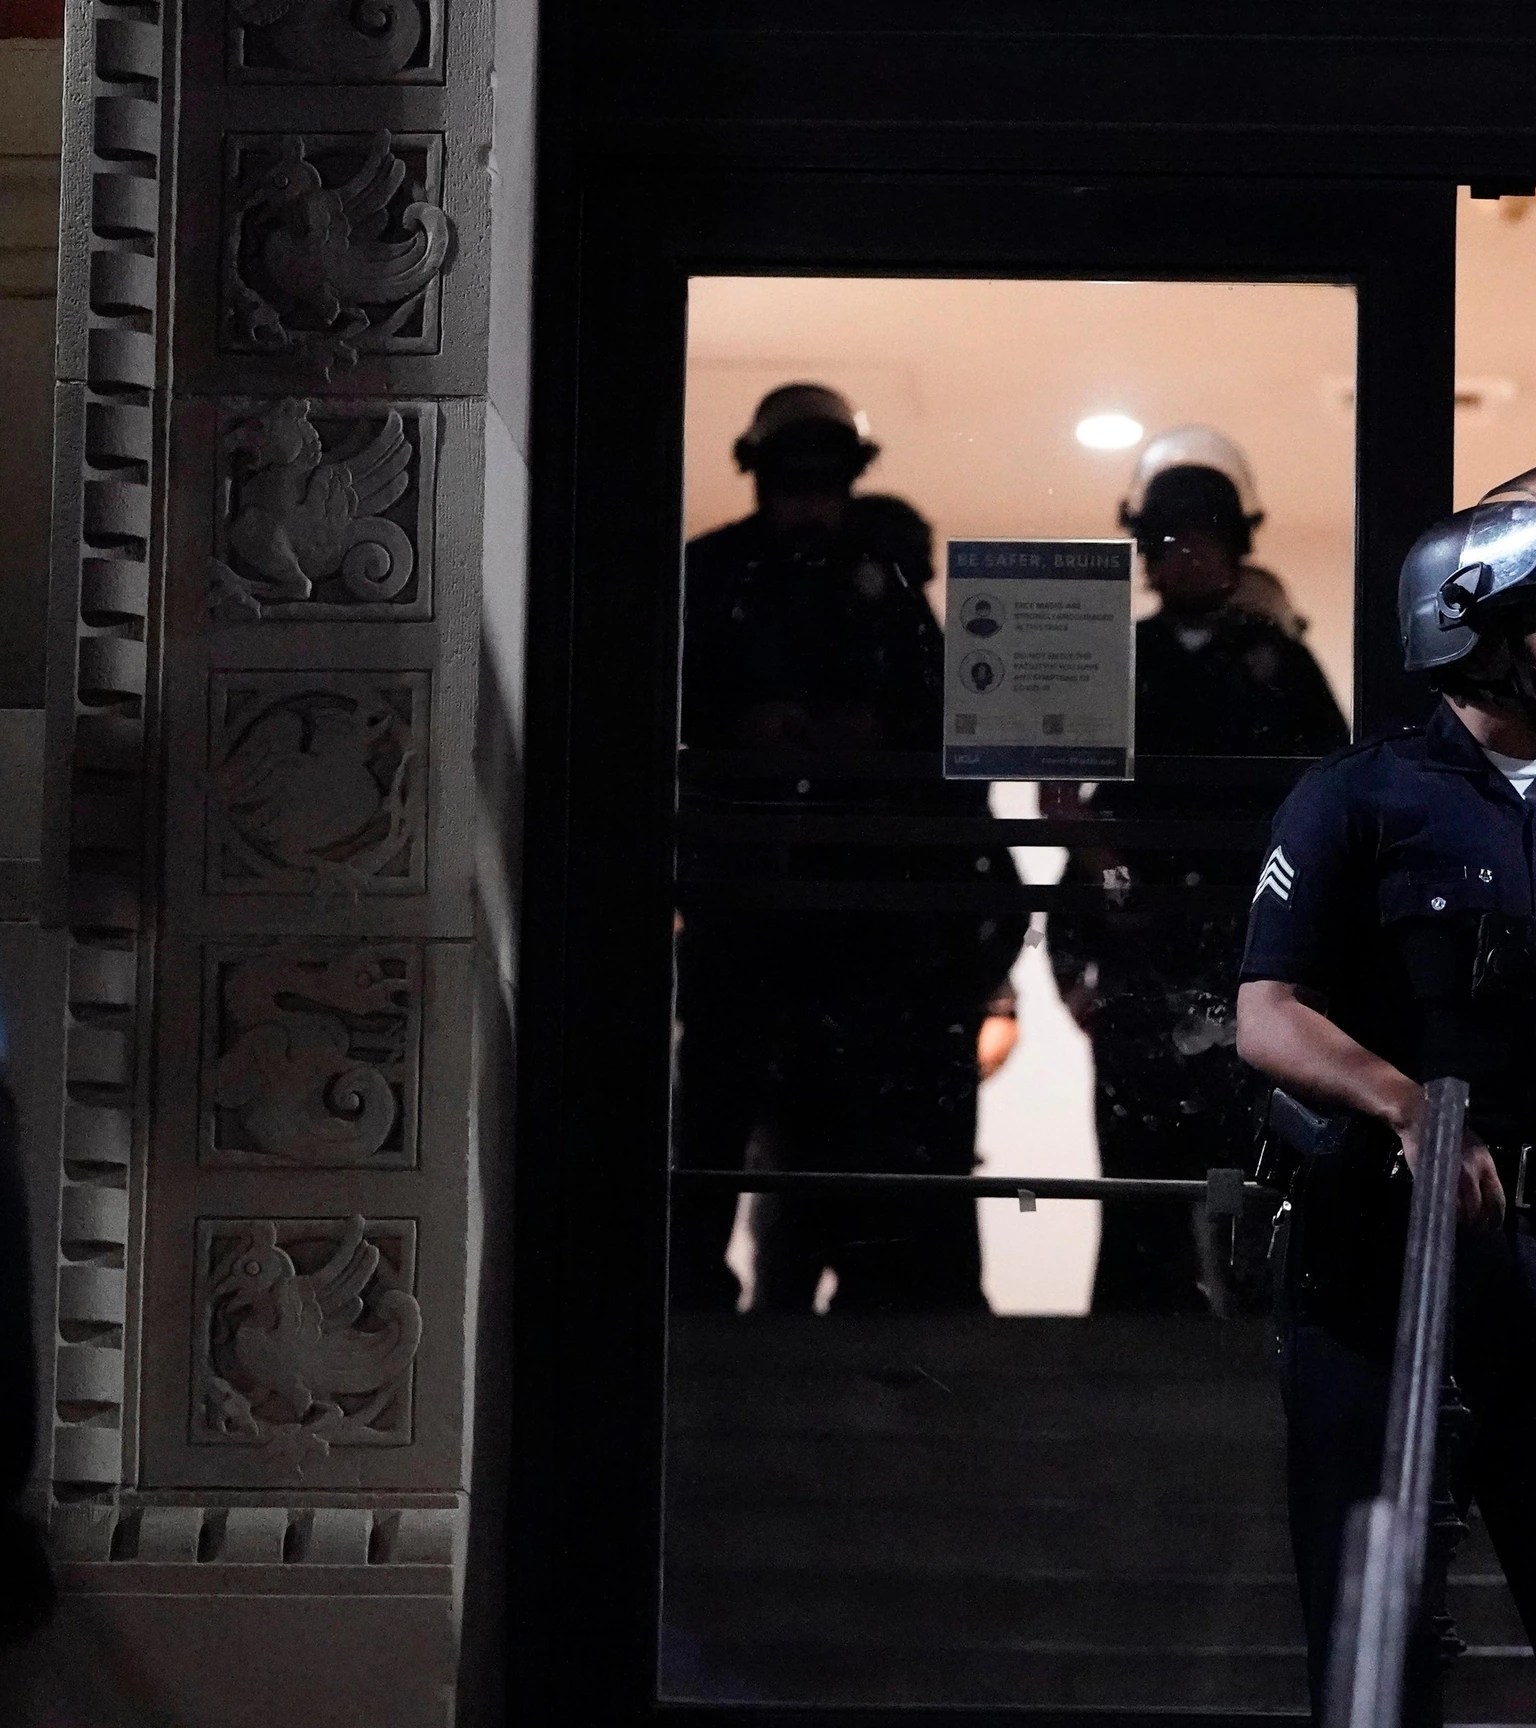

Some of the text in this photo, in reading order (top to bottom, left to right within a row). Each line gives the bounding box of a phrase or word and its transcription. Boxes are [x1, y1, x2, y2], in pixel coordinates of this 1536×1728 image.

[957, 553, 1120, 569] BE SAFER, BRUINS
